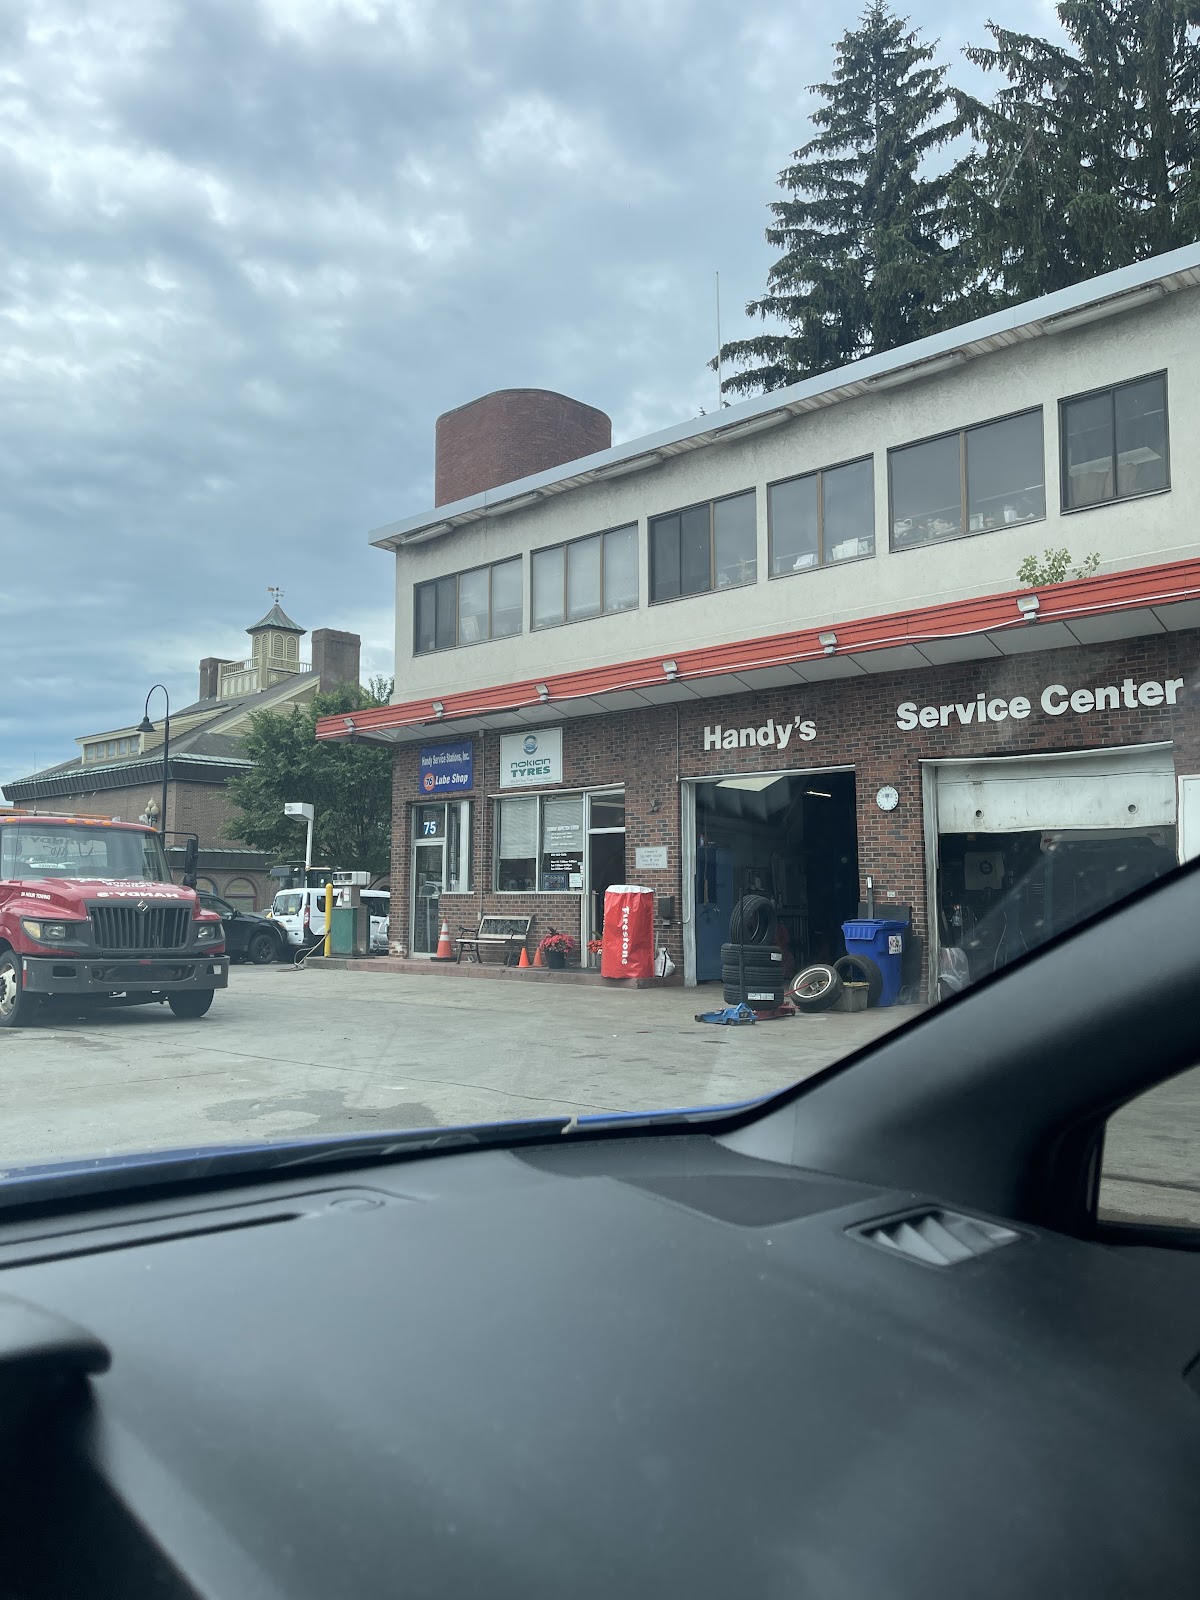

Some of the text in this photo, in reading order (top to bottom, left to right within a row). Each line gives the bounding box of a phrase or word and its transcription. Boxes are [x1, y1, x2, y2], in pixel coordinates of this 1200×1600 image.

[703, 677, 1184, 751] Handy's Service Center
[421, 755, 433, 768] Handy
[433, 753, 446, 765] Service
[462, 750, 470, 761] Inc.
[435, 774, 450, 785] Lube
[451, 773, 468, 785] Shop
[511, 766, 551, 778] TYRES
[423, 821, 437, 835] 75
[621, 905, 630, 965] Firestone
